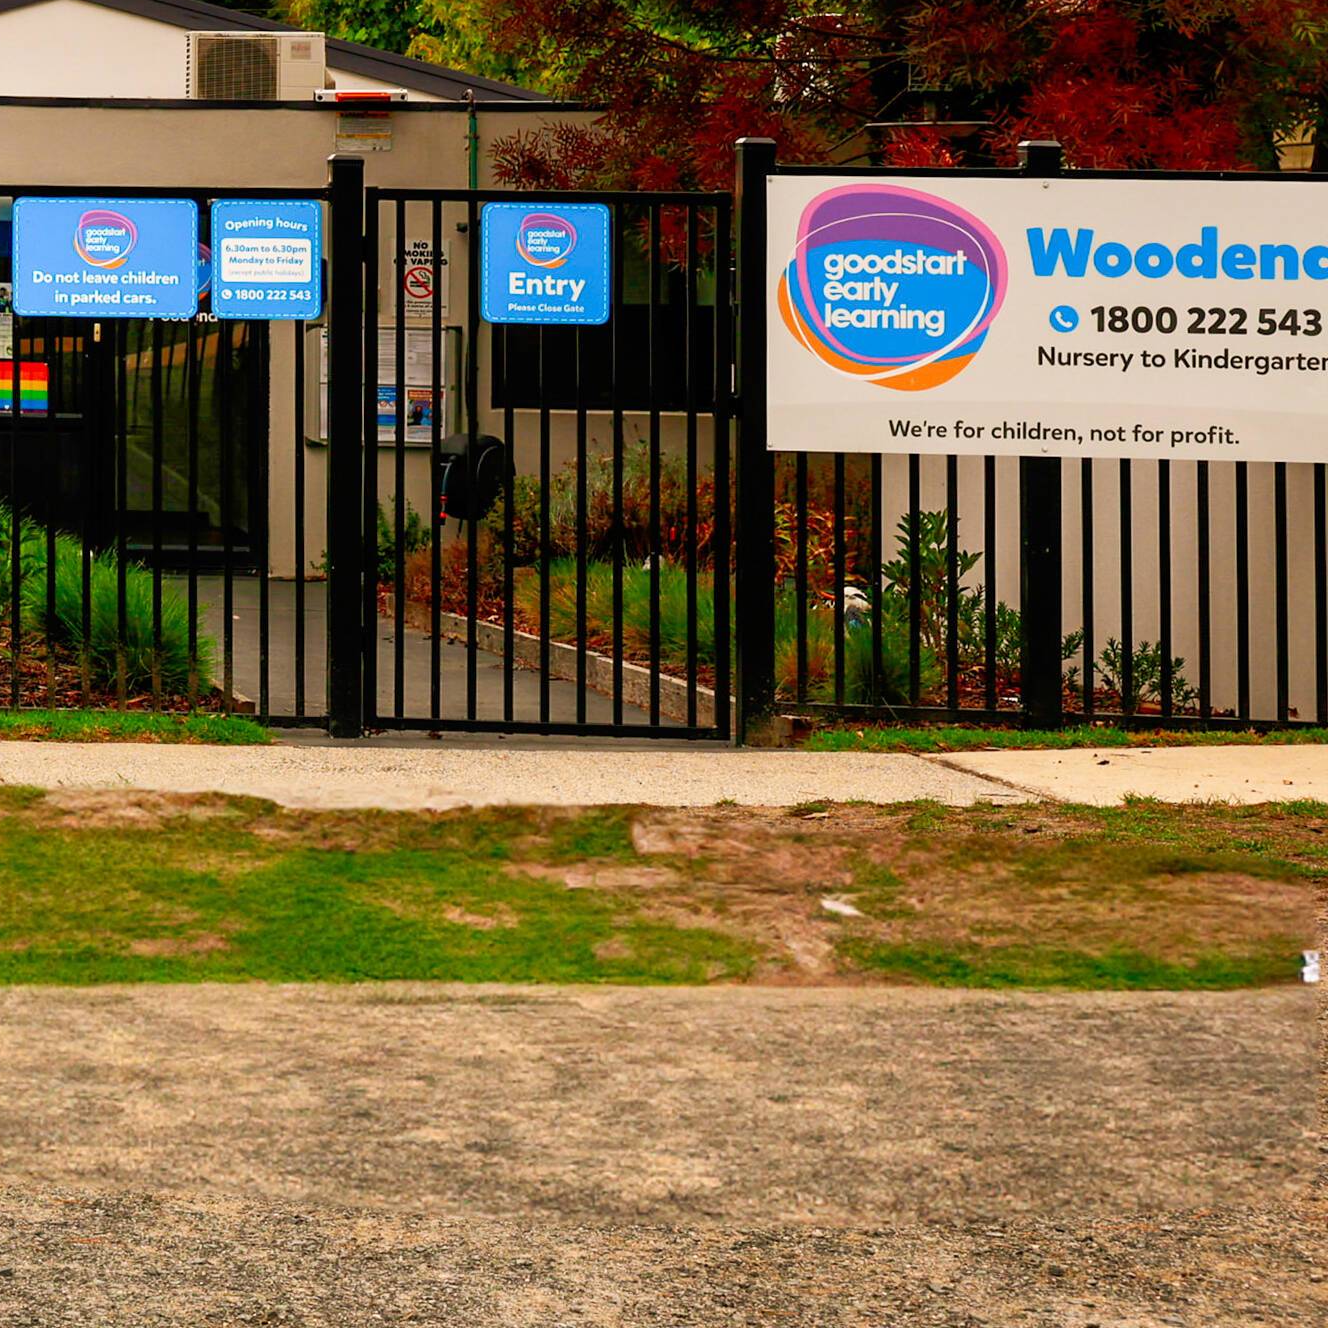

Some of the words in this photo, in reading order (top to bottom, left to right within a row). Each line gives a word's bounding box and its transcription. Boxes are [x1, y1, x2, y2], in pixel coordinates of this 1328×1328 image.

[225, 217, 274, 231] Opening
[276, 217, 308, 232] hours
[85, 227, 126, 238] goodstart
[85, 243, 120, 254] learning
[272, 245, 307, 254] 6.30pm
[229, 256, 264, 265] Monday
[276, 257, 304, 265] Friday
[824, 249, 967, 280] goodstart
[32, 271, 52, 284] Do
[55, 272, 80, 284] not
[82, 271, 118, 284] leave
[120, 271, 179, 285] children
[509, 272, 586, 302] Entry
[823, 276, 899, 307] early
[55, 290, 68, 303] in
[70, 290, 121, 306] parked
[123, 293, 156, 304] cars.
[235, 290, 264, 300] 1800
[266, 290, 287, 300] 222
[289, 290, 312, 301] 543
[508, 303, 536, 311] Please
[538, 303, 562, 312] Close
[563, 304, 585, 312] Gate
[825, 303, 945, 337] learning
[1090, 305, 1178, 334] 1800
[1187, 307, 1248, 335] 222
[1256, 308, 1323, 336] 543
[1037, 346, 1134, 372] Nursery
[1140, 349, 1166, 368] to
[888, 420, 947, 438] We're
[954, 420, 985, 439] for
[991, 422, 1084, 445] children,
[1090, 425, 1126, 442] not
[1132, 424, 1164, 443] for
[1171, 425, 1240, 448] profit.
